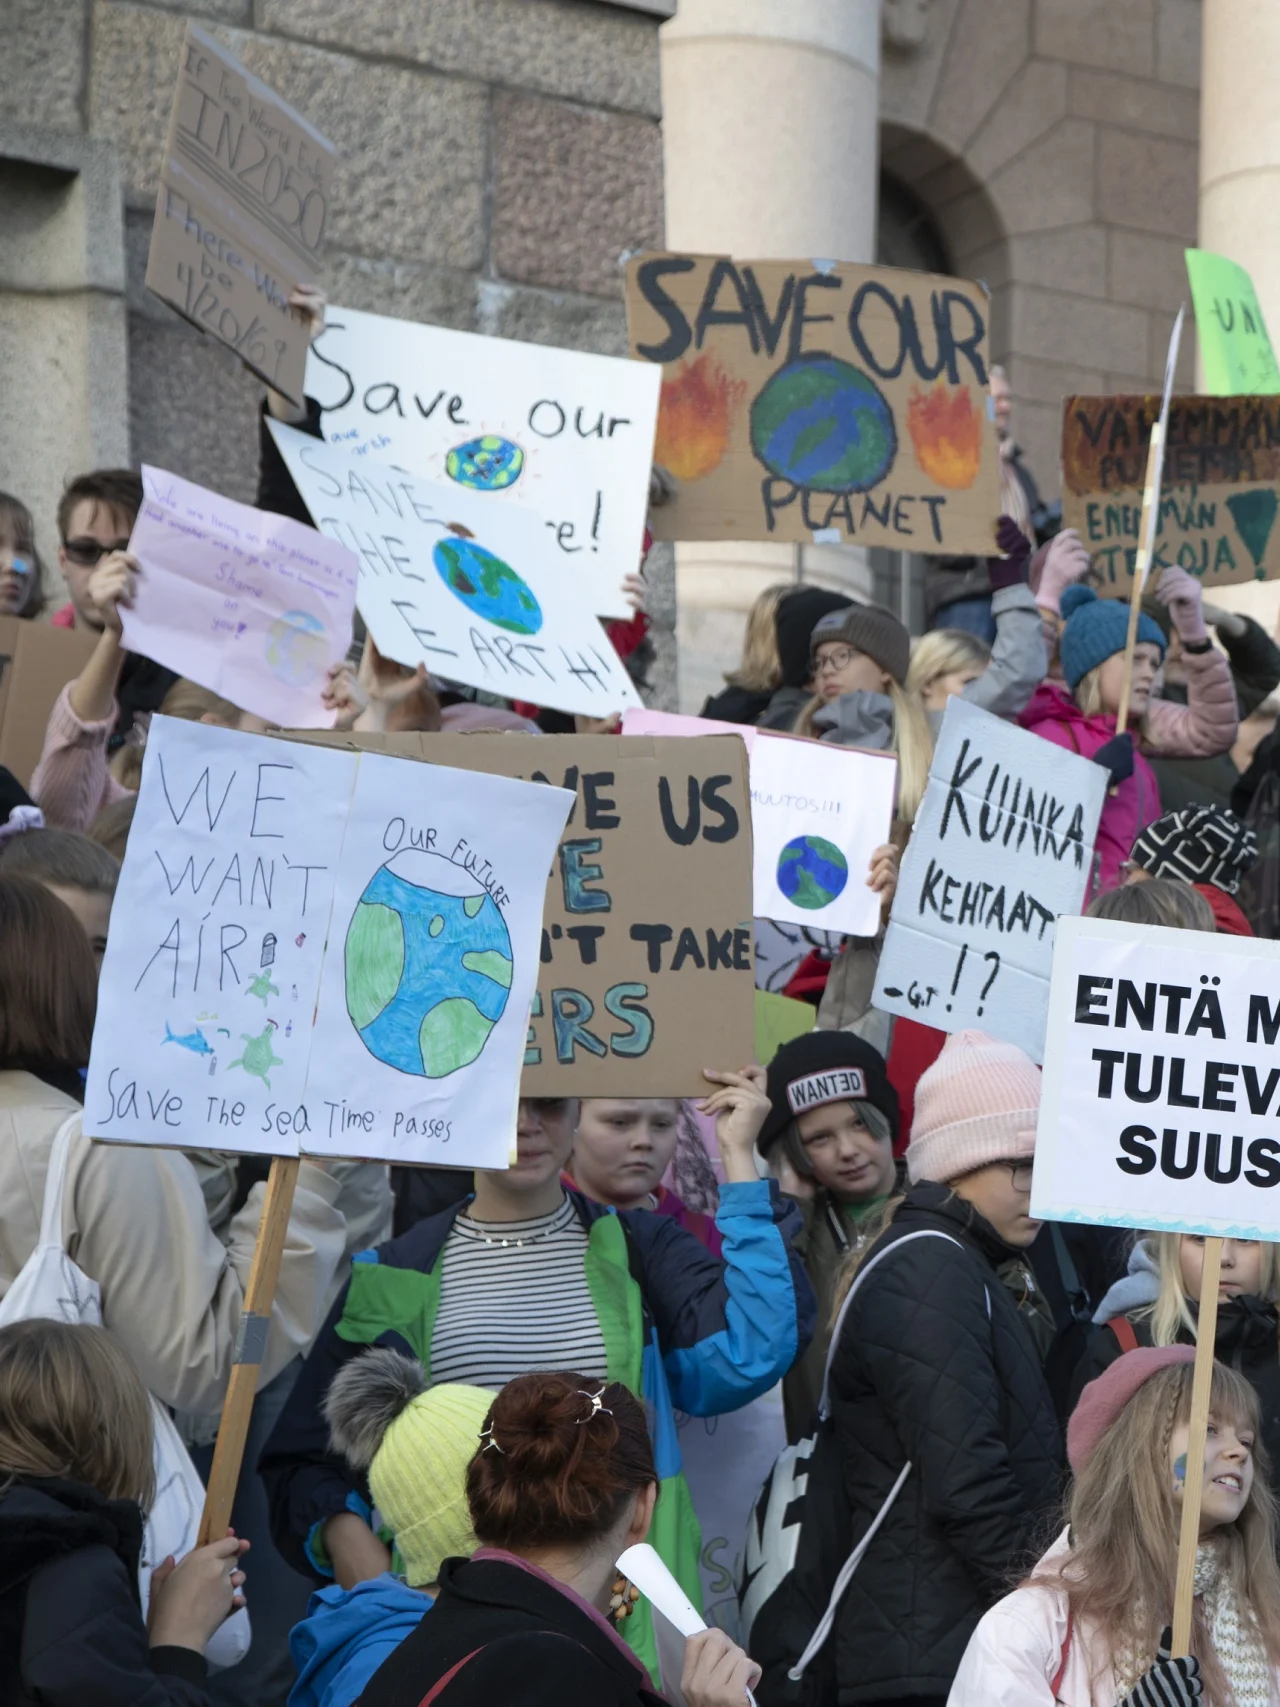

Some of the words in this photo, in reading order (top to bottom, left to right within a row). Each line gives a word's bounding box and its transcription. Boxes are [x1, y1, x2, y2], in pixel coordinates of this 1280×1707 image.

[636, 258, 843, 363] SAVE
[848, 280, 990, 386] OUR
[310, 323, 470, 426] Save
[528, 399, 632, 440] Our
[299, 446, 447, 526] SAVE
[761, 474, 946, 544] PLANET
[320, 518, 425, 583] THE
[157, 752, 295, 838] WE
[657, 774, 740, 846] US
[938, 738, 1086, 871] KUINKA
[382, 816, 439, 853] OUR
[451, 837, 511, 908] FUTURE
[918, 857, 1056, 941] KEHTAAT
[629, 922, 753, 974] TAKE
[1074, 973, 1227, 1040] ENTÄ
[97, 1067, 184, 1128] Save
[206, 1095, 246, 1128] The
[322, 1098, 375, 1139] Time
